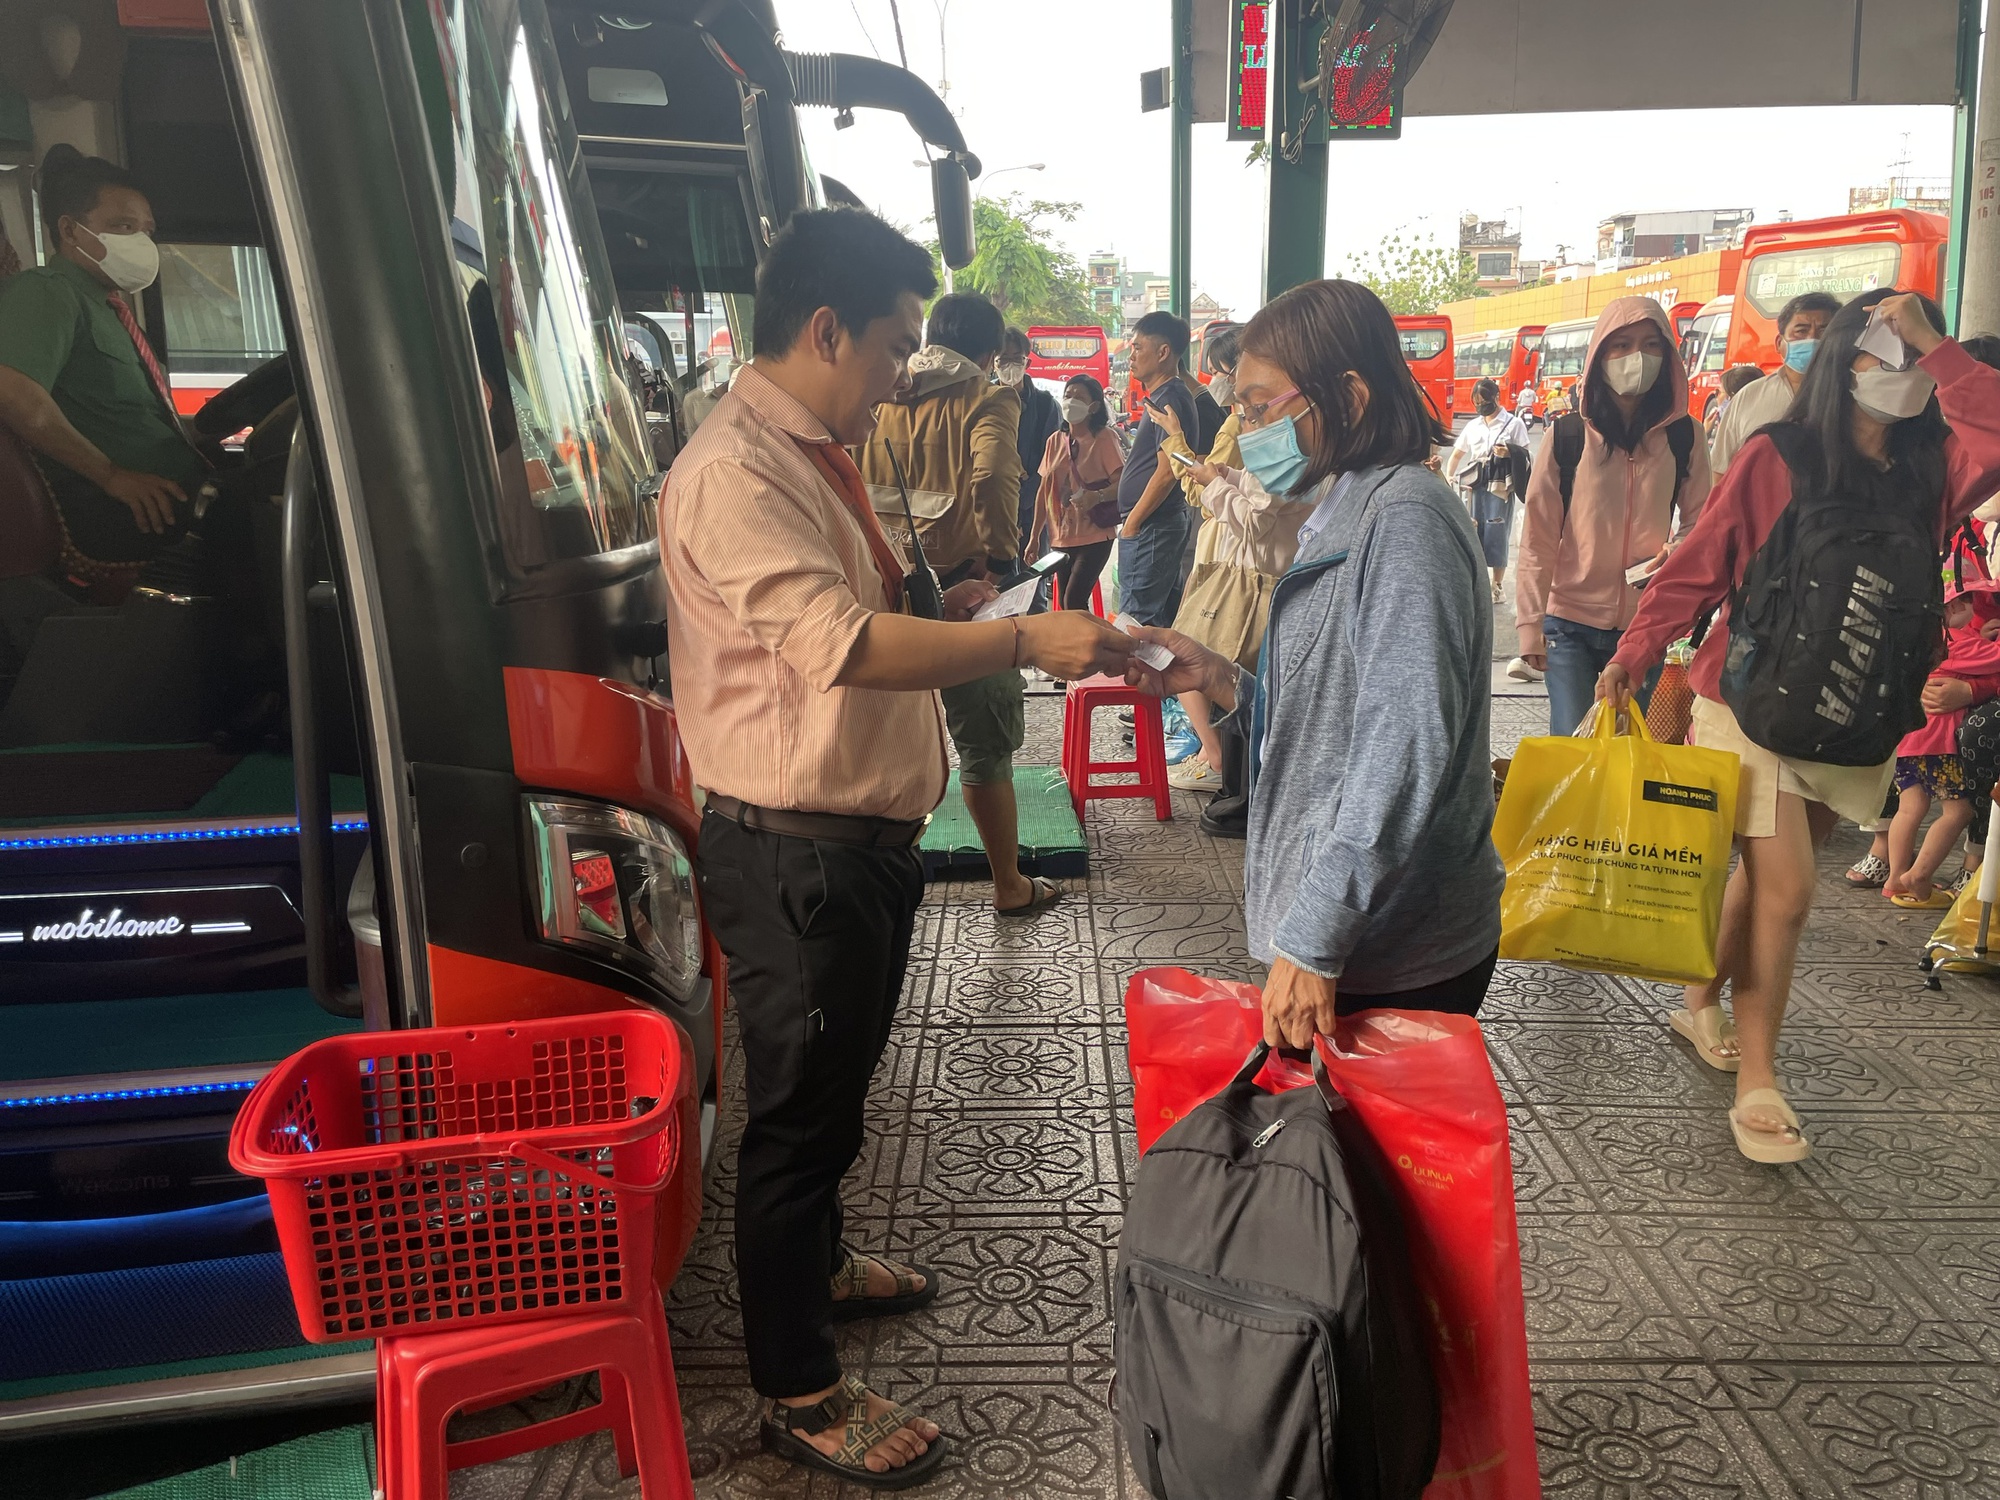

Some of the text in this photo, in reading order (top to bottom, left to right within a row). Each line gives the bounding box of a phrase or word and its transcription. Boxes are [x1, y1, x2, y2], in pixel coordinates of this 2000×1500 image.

[1987, 167, 1995, 178] 2
[1823, 277, 1862, 292] TRANG
[1044, 362, 1086, 370] mobihome
[1583, 838, 1621, 853] HIỆU
[1664, 846, 1702, 865] MỀM
[1640, 864, 1651, 872] TA
[1665, 867, 1679, 876] TIN
[32, 908, 184, 941] mobihome
